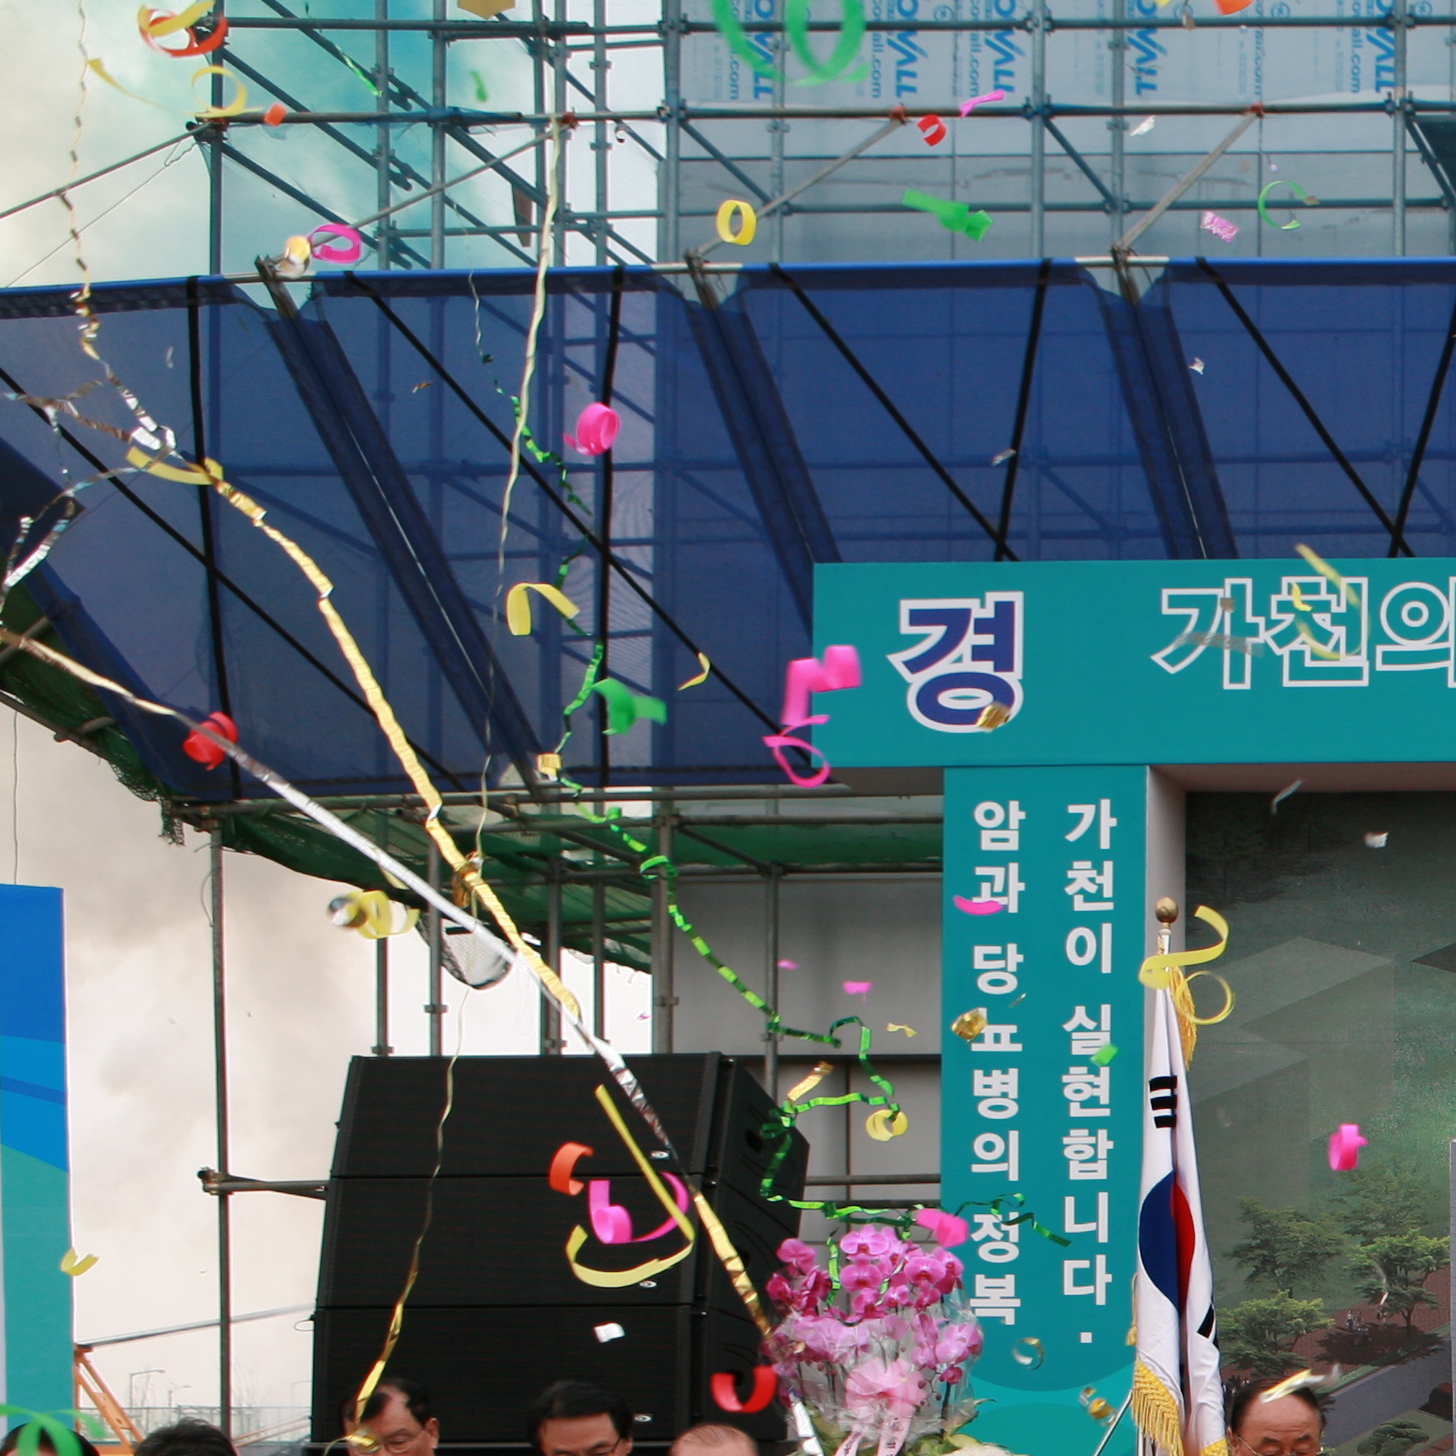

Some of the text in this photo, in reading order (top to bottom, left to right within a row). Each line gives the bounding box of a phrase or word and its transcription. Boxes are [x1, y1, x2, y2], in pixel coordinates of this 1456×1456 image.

[886, 591, 1024, 733] 경
[1063, 798, 1117, 974] 가천이
[969, 800, 1026, 1326] 암과 당뇨병의 정복
